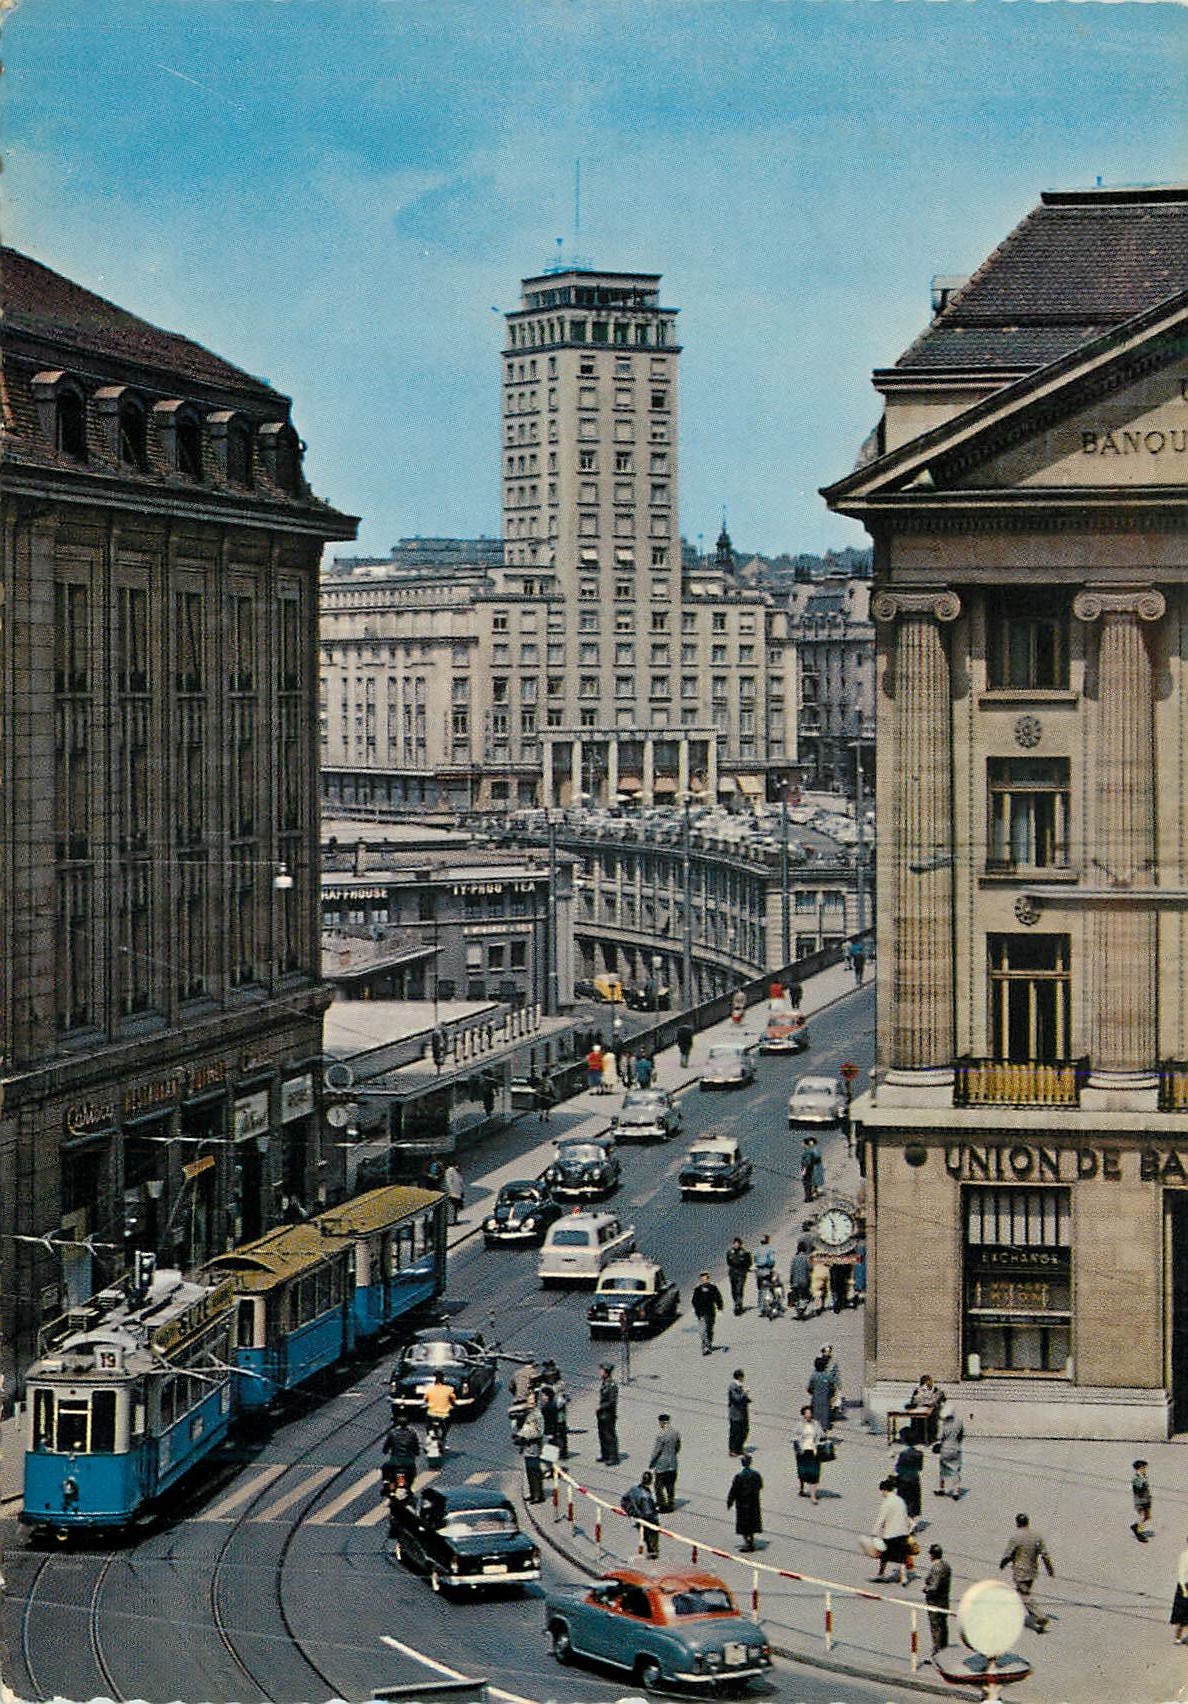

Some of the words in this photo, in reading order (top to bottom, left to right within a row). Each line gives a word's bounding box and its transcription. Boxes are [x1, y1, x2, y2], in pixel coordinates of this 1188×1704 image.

[514, 882, 536, 892] TEA
[945, 1144, 1062, 1182] UNION
[1077, 1148, 1122, 1182] DE
[1141, 1148, 1188, 1183] BA
